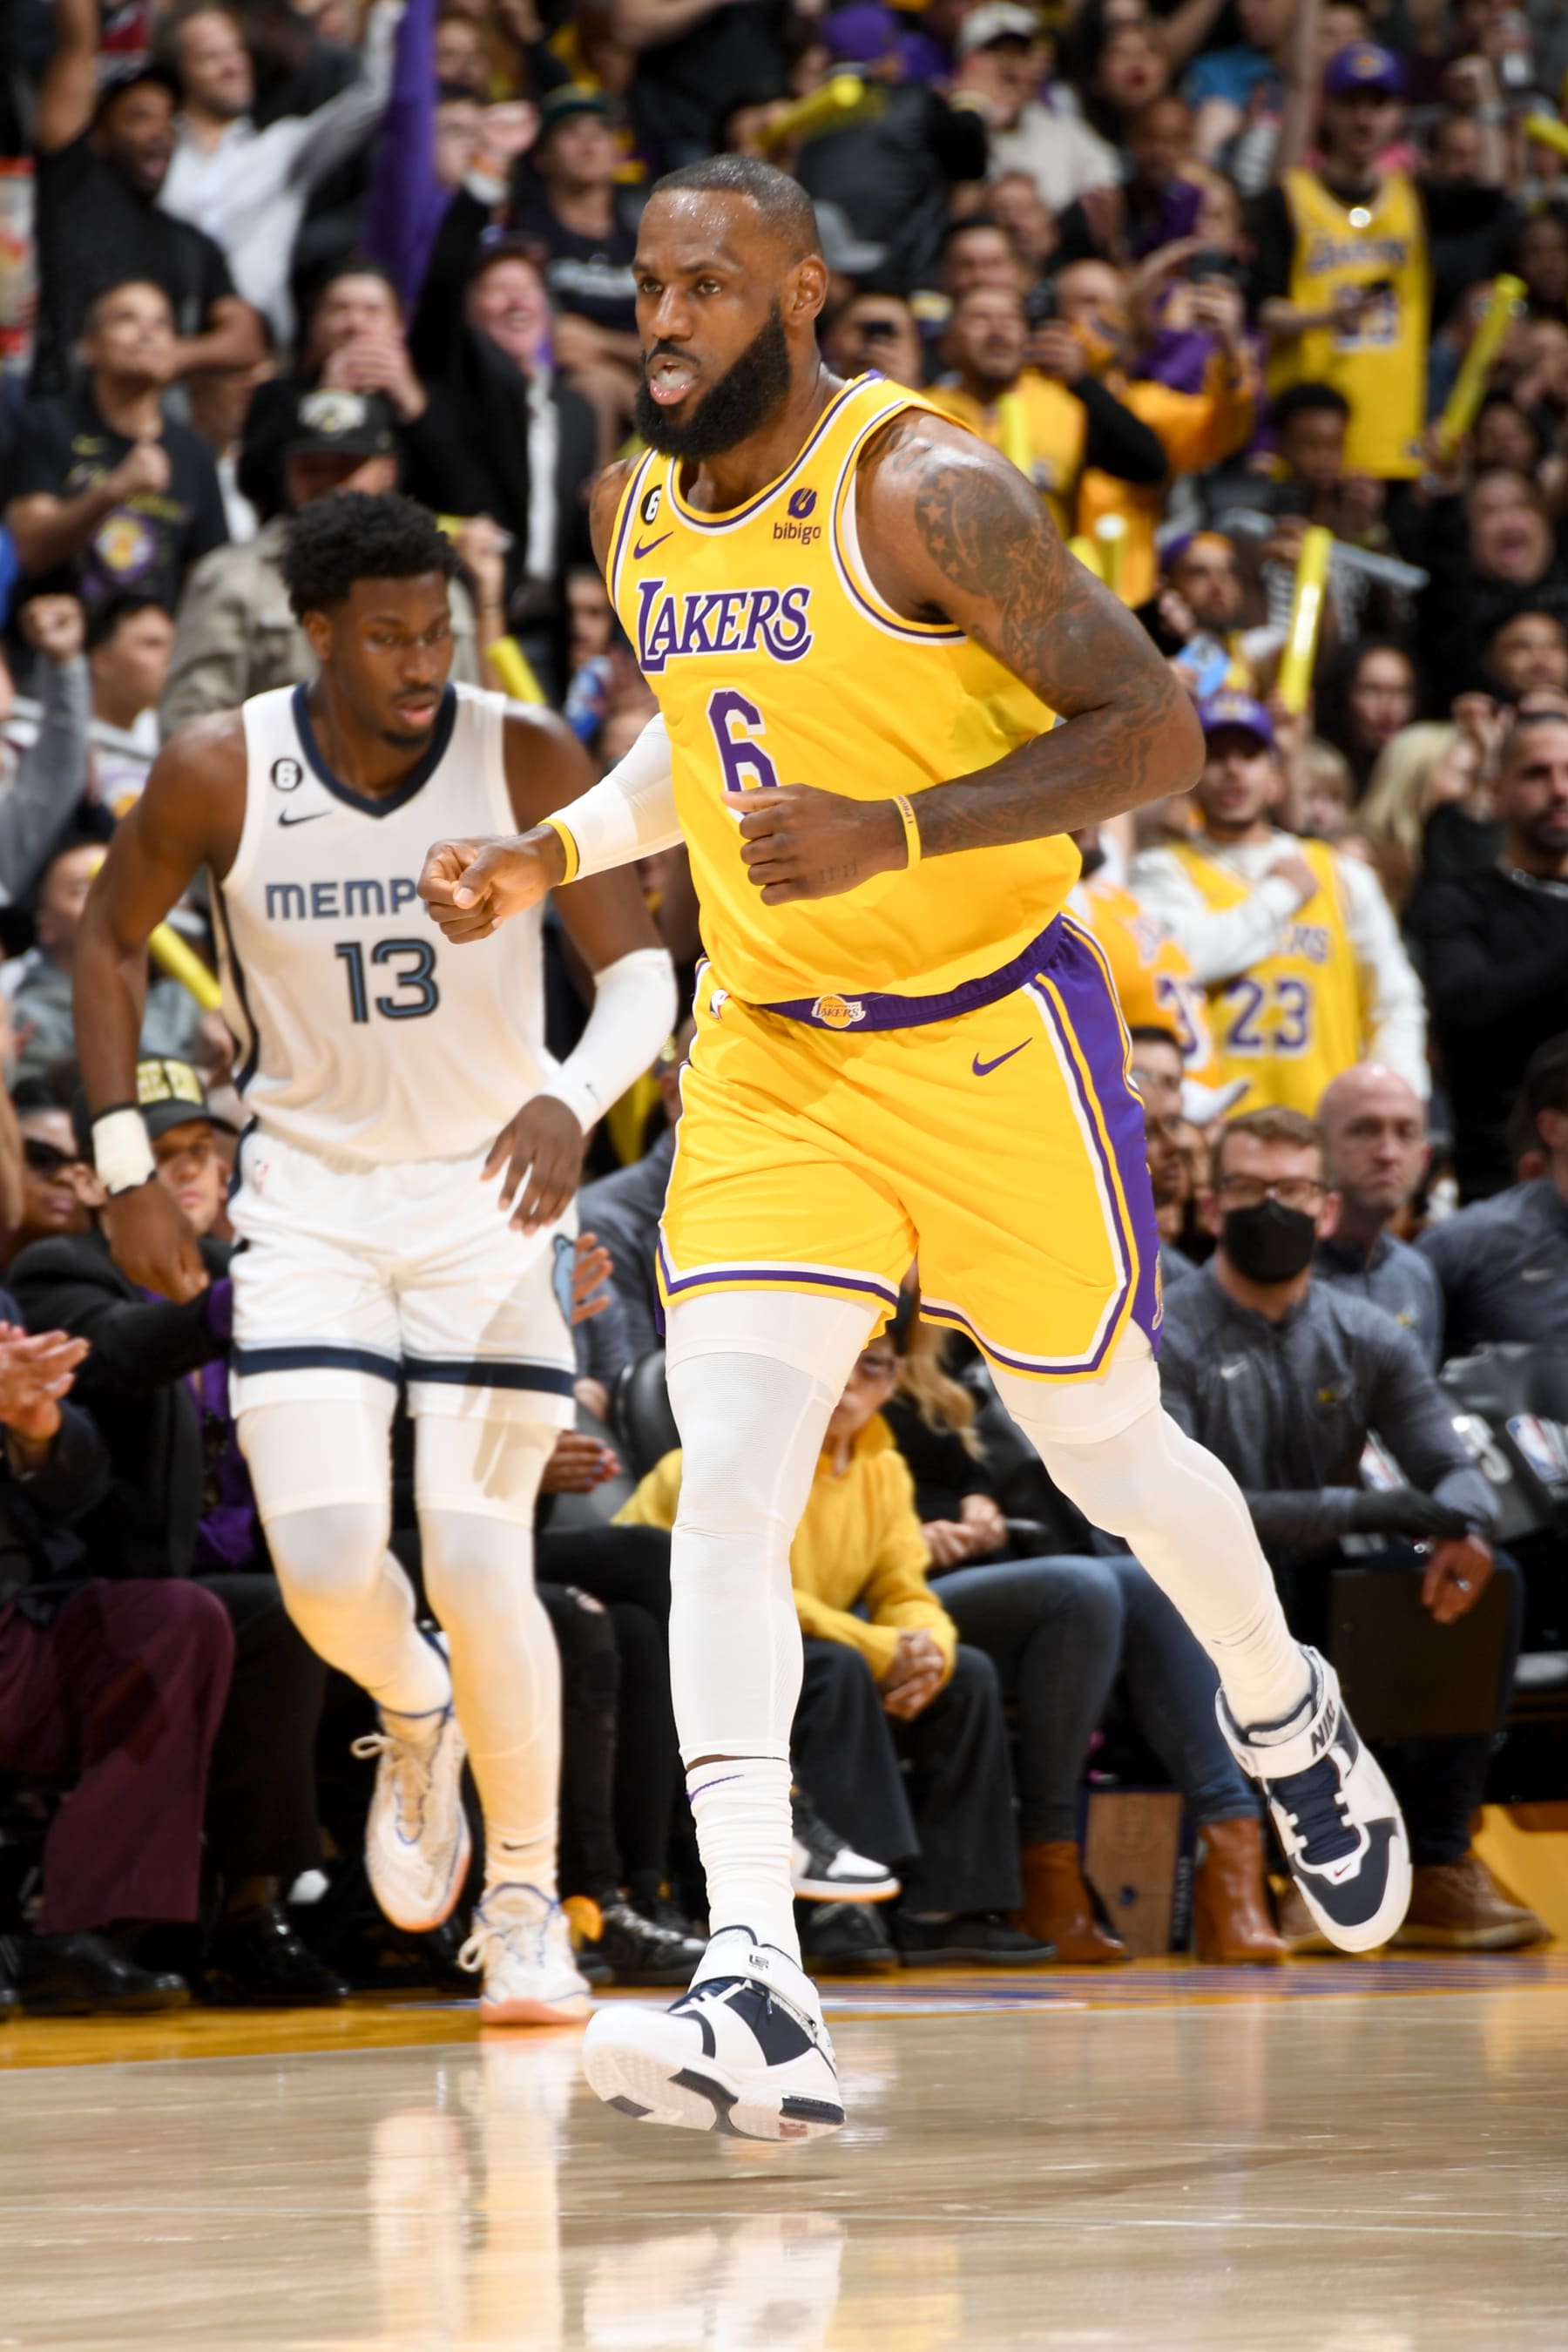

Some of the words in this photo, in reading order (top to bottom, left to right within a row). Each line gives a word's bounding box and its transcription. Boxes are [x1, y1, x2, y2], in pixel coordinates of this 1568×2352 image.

[773, 523, 821, 545] bibigo
[636, 578, 814, 674] LAKERS
[706, 686, 781, 822] 6
[265, 878, 430, 921] MEMP
[334, 937, 441, 1024] 13
[1221, 975, 1315, 1056] 23
